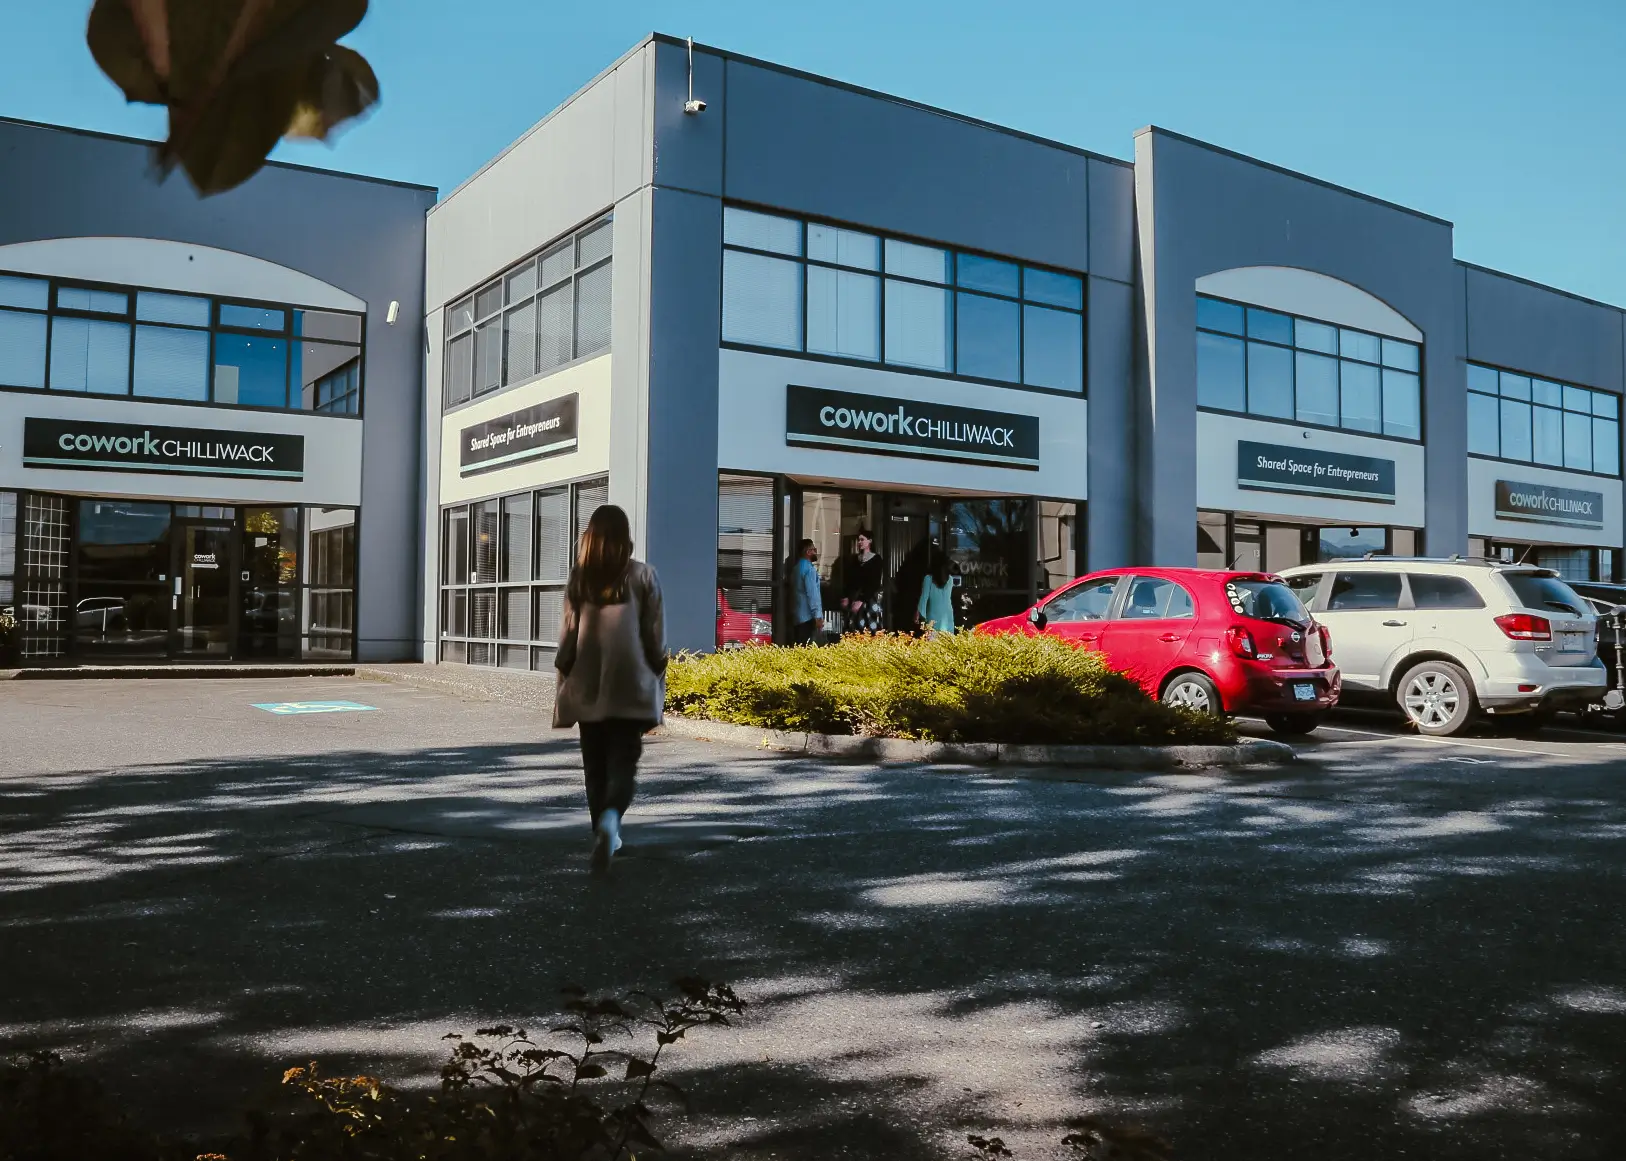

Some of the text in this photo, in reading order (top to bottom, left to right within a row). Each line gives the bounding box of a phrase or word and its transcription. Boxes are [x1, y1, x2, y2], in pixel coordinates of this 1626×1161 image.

[471, 417, 560, 451] Shared Space for Entrepreneurs
[820, 406, 1014, 448] cowork CHILLIWACK
[58, 430, 274, 462] cowork CHILLIWACK
[1257, 455, 1379, 482] Shared Space for Entrepreneurs
[1509, 490, 1593, 515] cowork CHILLIWACK
